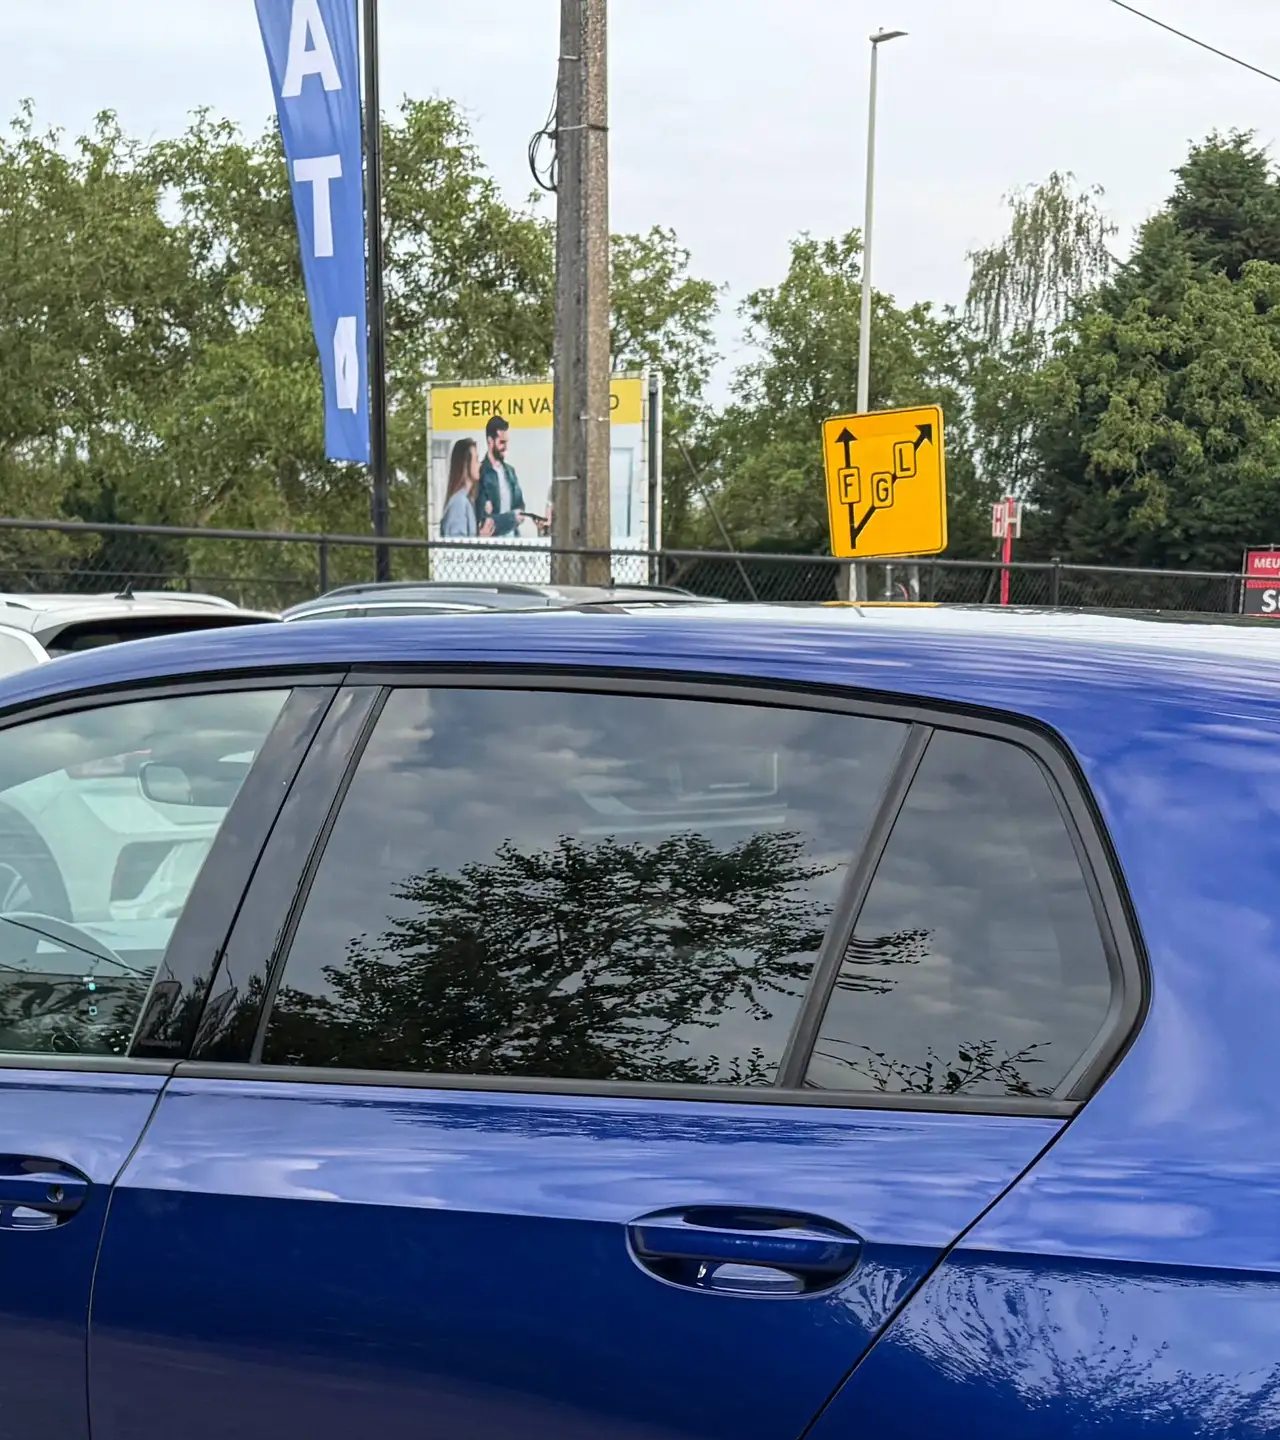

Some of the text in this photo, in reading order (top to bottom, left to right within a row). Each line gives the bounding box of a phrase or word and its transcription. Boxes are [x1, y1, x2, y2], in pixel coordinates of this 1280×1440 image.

[452, 398, 504, 418] STERK
[507, 397, 524, 415] IN
[898, 447, 911, 472] L
[843, 473, 855, 498] F
[876, 478, 889, 502] G
